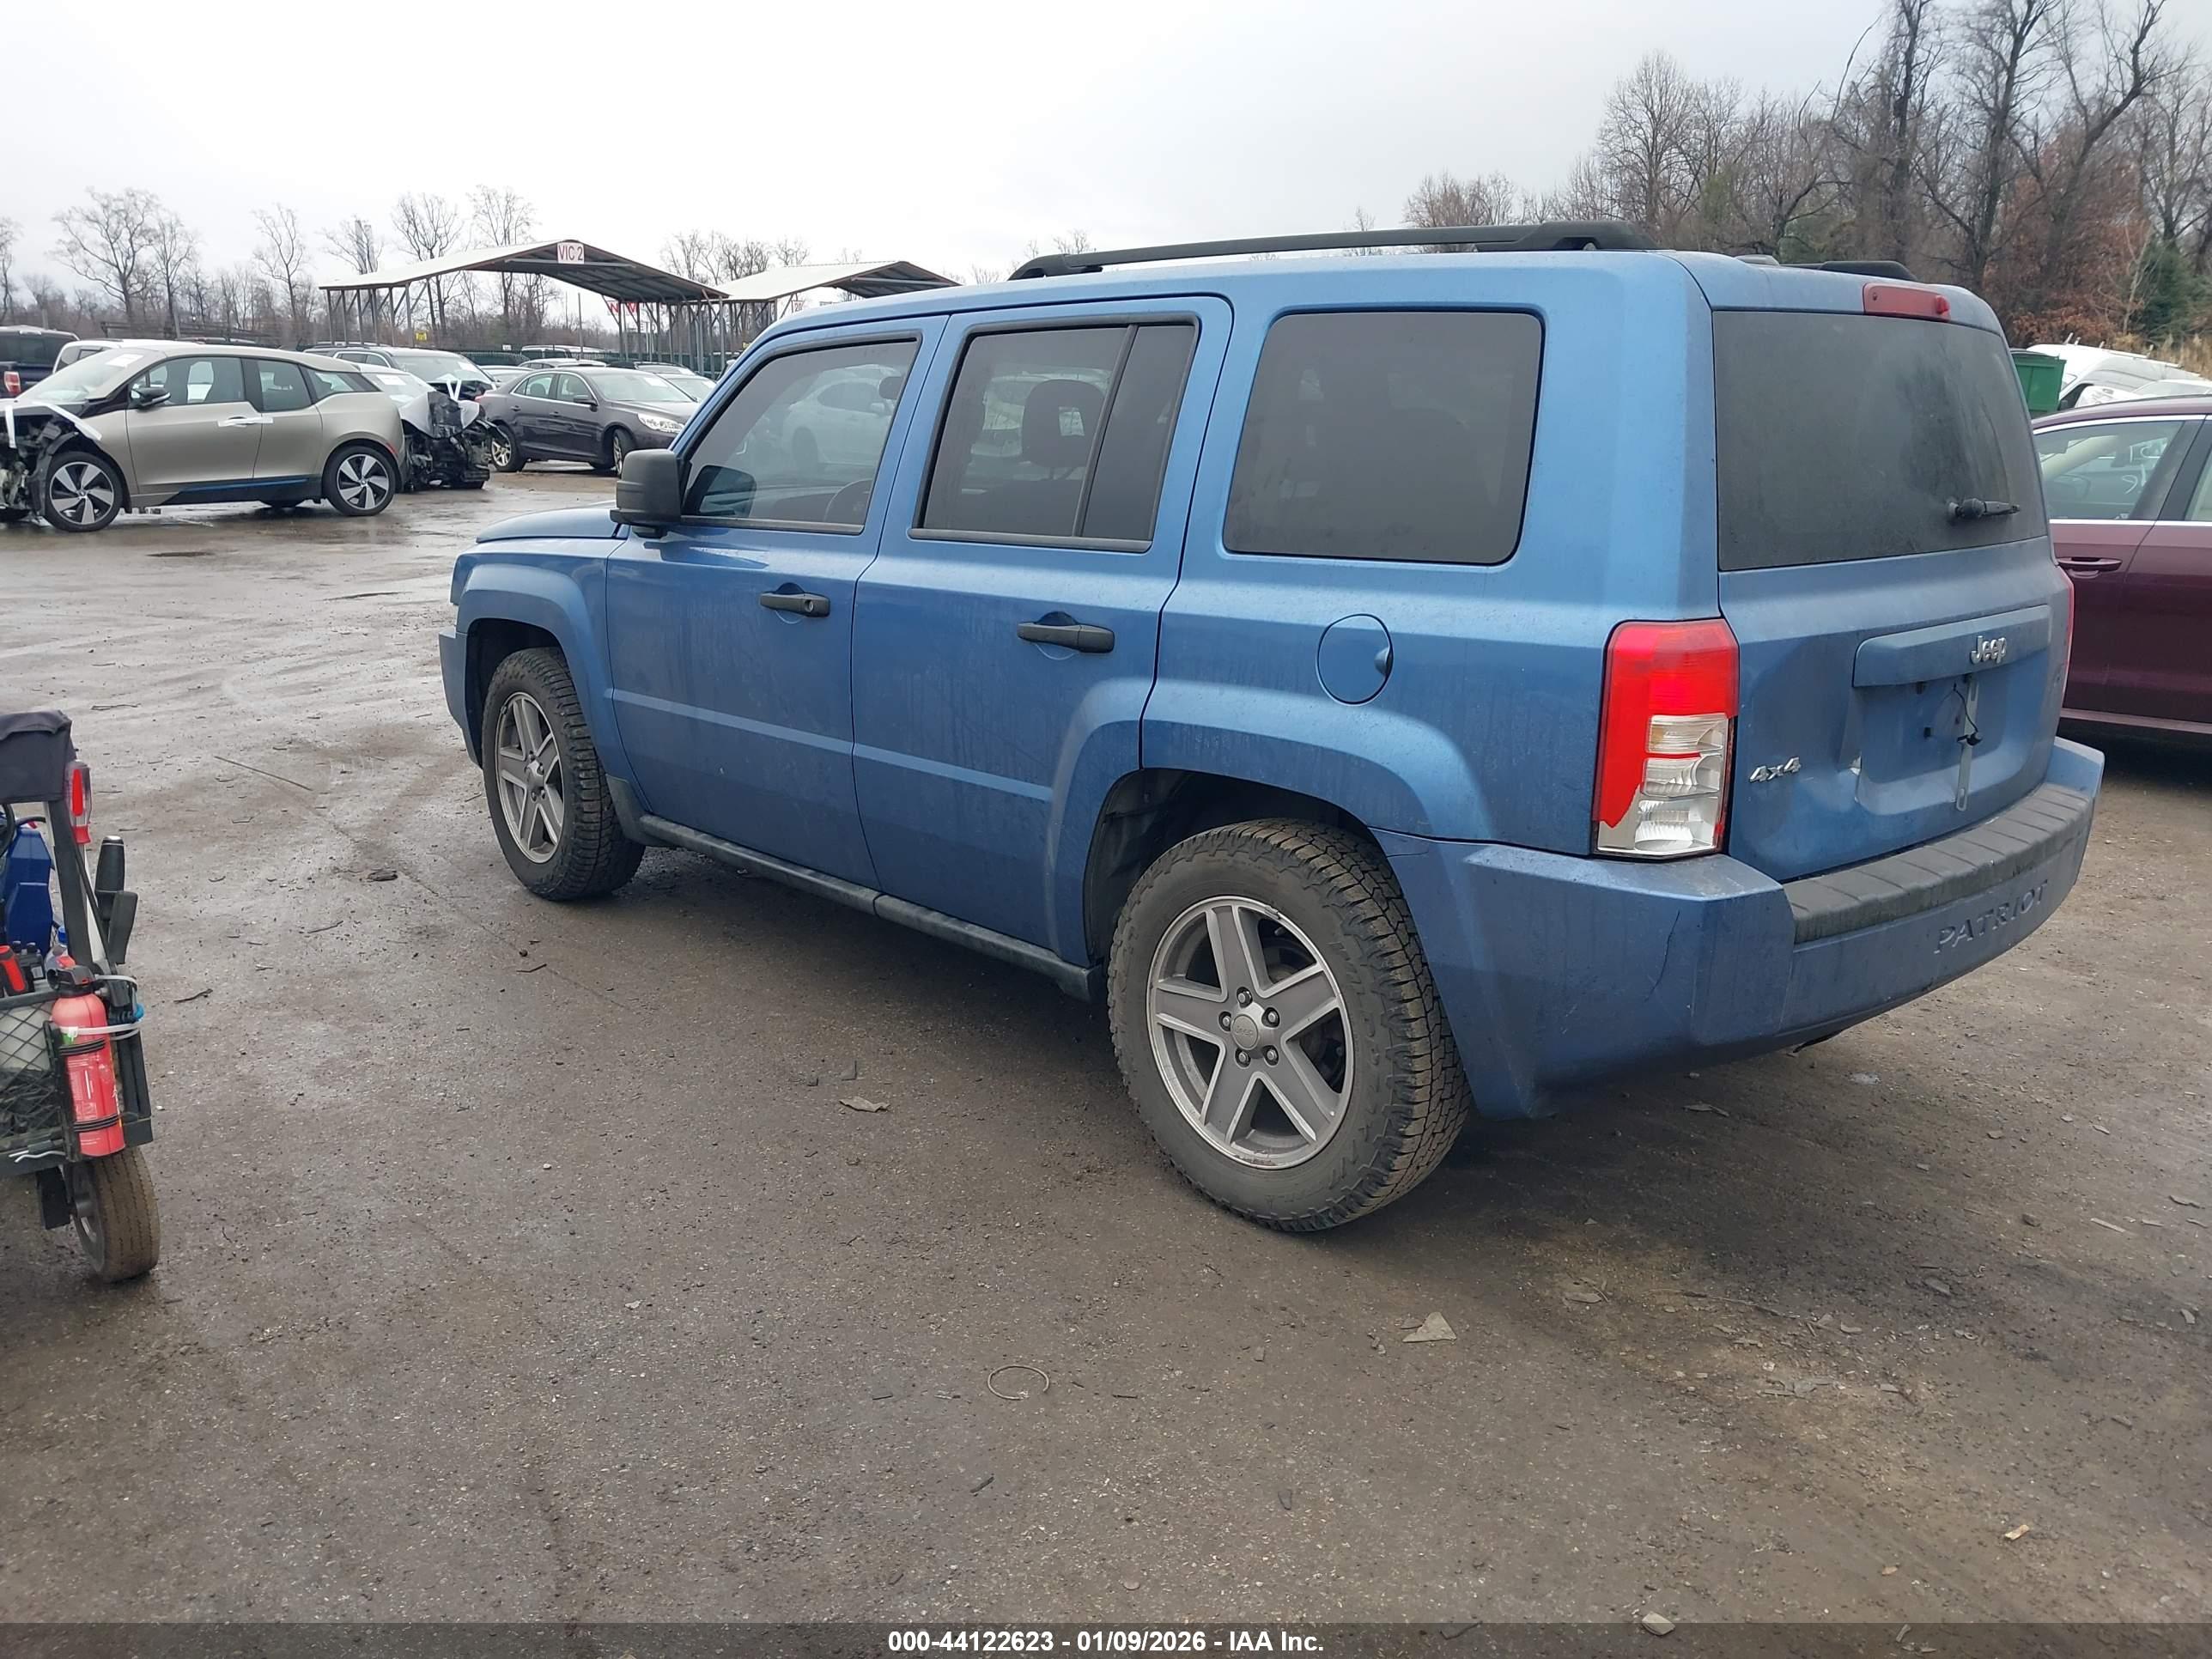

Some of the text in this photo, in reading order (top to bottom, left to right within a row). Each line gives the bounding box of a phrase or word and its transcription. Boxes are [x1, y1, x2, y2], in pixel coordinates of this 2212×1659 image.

[558, 245, 584, 261] VIC 2
[1970, 635, 2006, 664] Jeep
[1749, 757, 1802, 783] 4x4
[1934, 879, 2048, 954] PATRIOT
